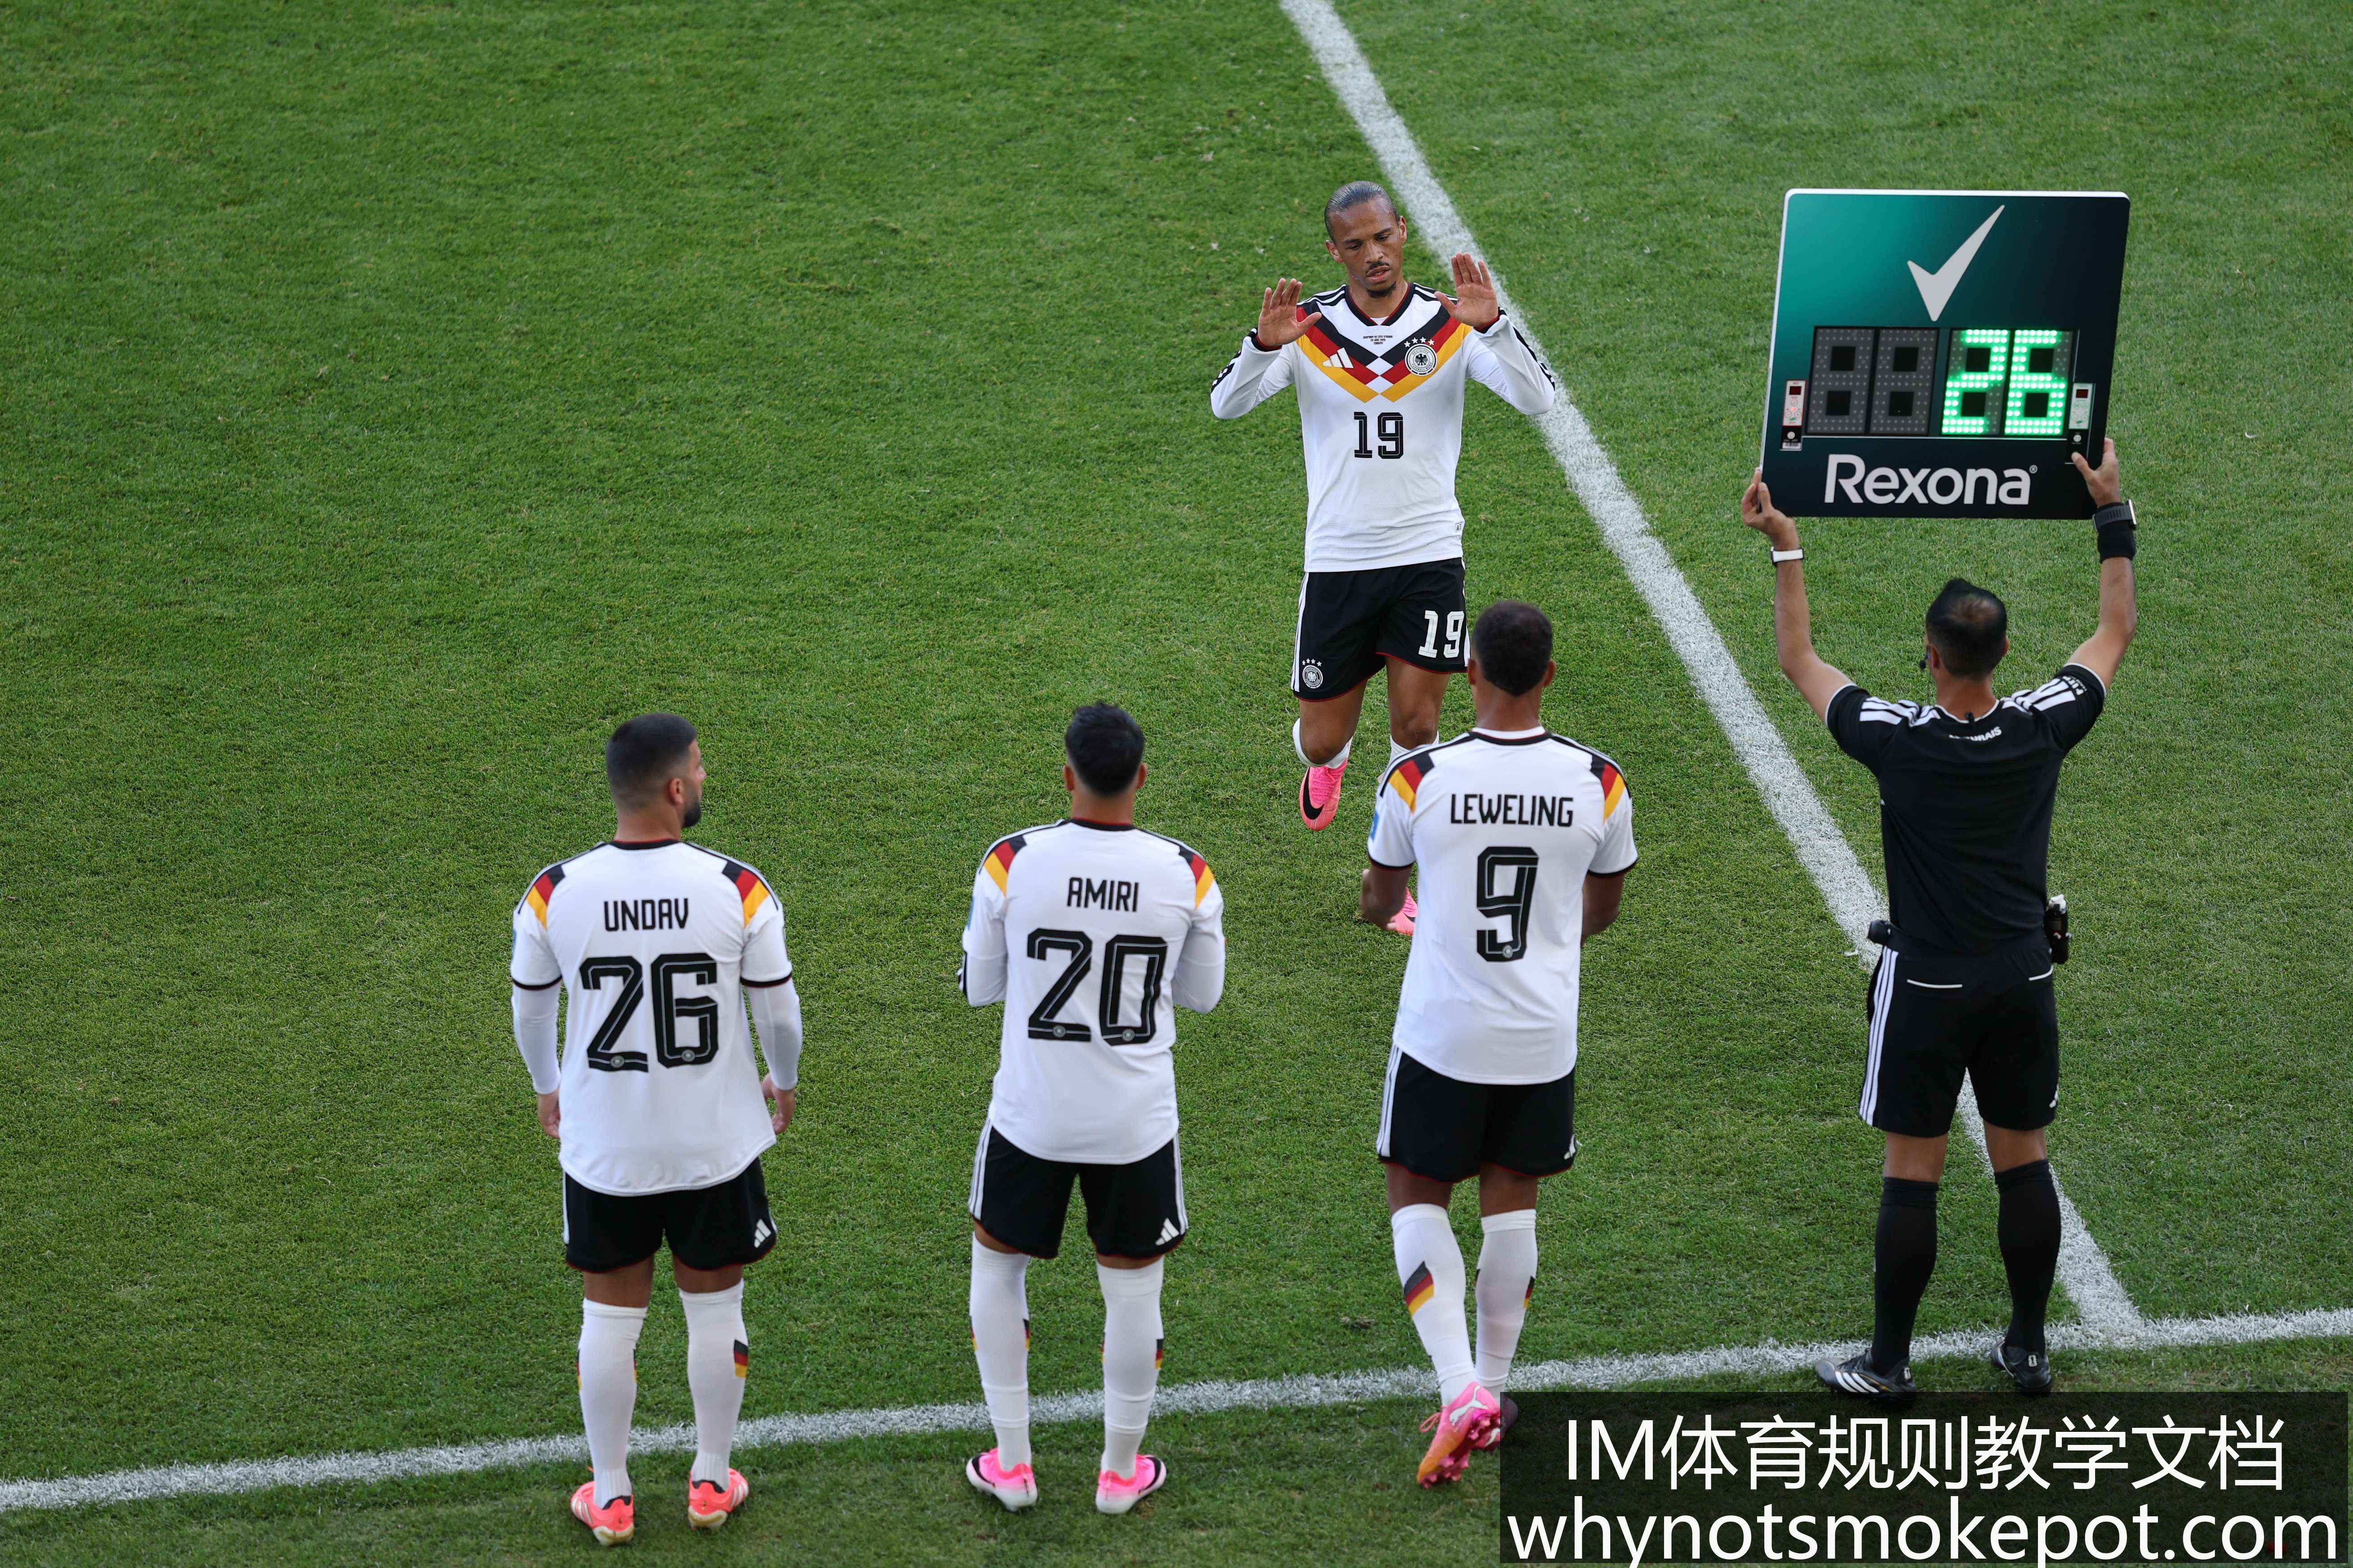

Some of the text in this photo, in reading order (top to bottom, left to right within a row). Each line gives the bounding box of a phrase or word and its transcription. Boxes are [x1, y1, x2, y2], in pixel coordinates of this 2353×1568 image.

[1941, 329, 2066, 435] 26
[1354, 412, 1404, 459] 19
[1418, 610, 1465, 658] 19
[1451, 794, 1573, 827] LEWELING
[604, 898, 688, 932] UNDAV
[1067, 877, 1139, 912] AMIRI
[1477, 846, 1539, 962] 9
[1027, 928, 1168, 1046] 20
[579, 952, 719, 1073] 26
